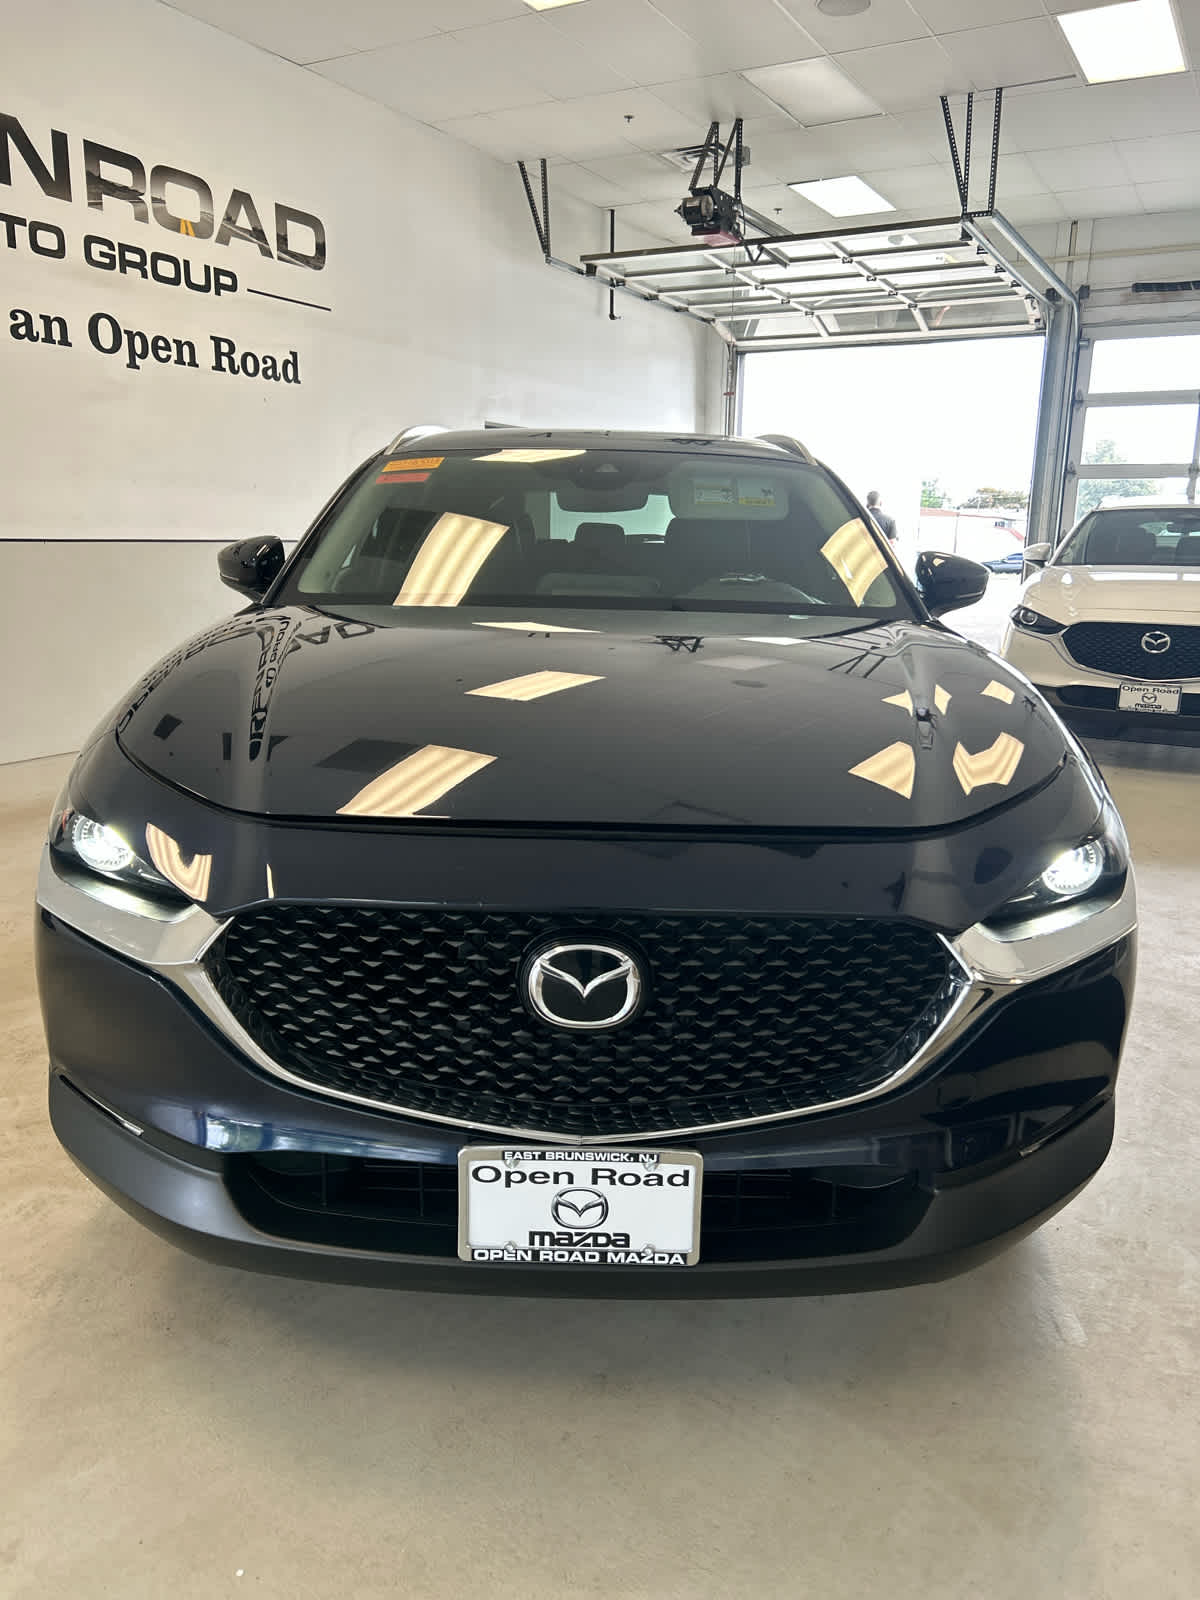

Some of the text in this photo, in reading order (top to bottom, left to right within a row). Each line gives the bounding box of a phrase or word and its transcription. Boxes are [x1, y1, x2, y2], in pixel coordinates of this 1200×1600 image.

[0, 212, 239, 297] TO GROUP
[9, 307, 302, 385] an Open Road
[1122, 685, 1149, 693] Open
[504, 1151, 541, 1161] EAST
[638, 1153, 658, 1163] NJ
[471, 1165, 690, 1188] Open Road
[528, 1230, 631, 1249] mazda
[473, 1250, 685, 1265] OPEN ROAD MAZDA
